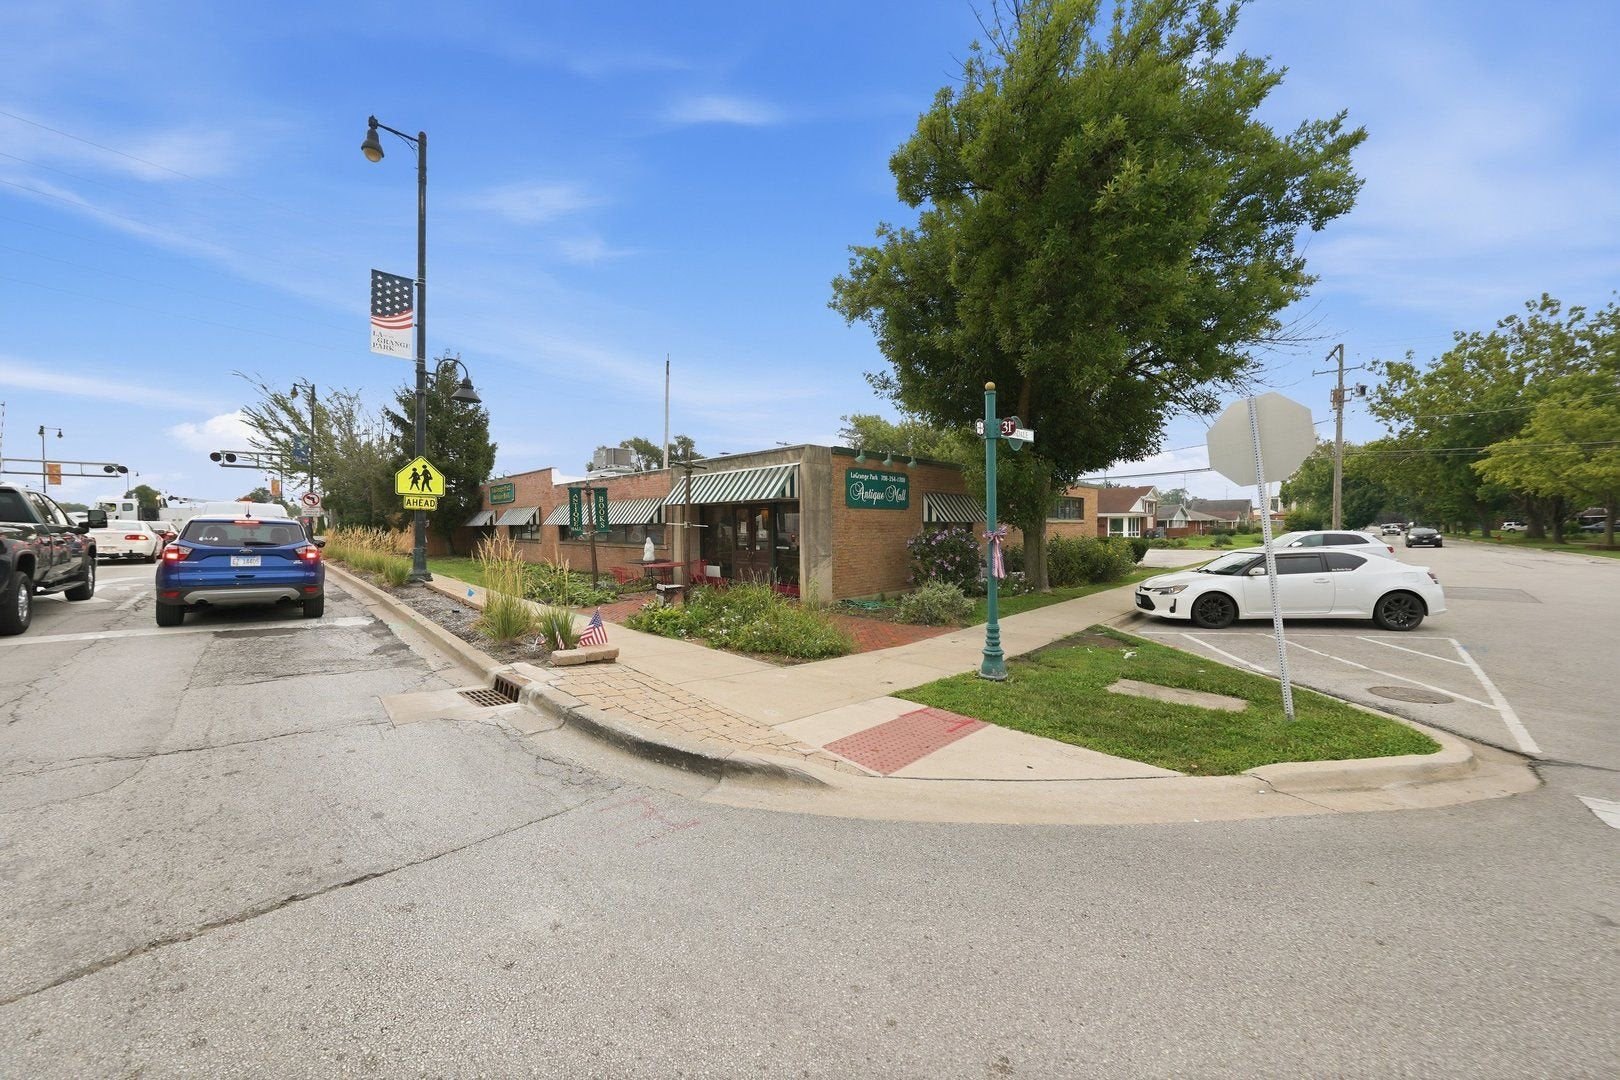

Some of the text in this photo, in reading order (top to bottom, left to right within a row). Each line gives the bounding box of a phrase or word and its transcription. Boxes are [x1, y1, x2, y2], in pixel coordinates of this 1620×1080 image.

[372, 342, 395, 351] PARK
[377, 336, 410, 349] GRANGE
[850, 481, 906, 505] Antique Mall
[406, 498, 436, 507] AHEAD
[598, 496, 606, 528] BOOKS
